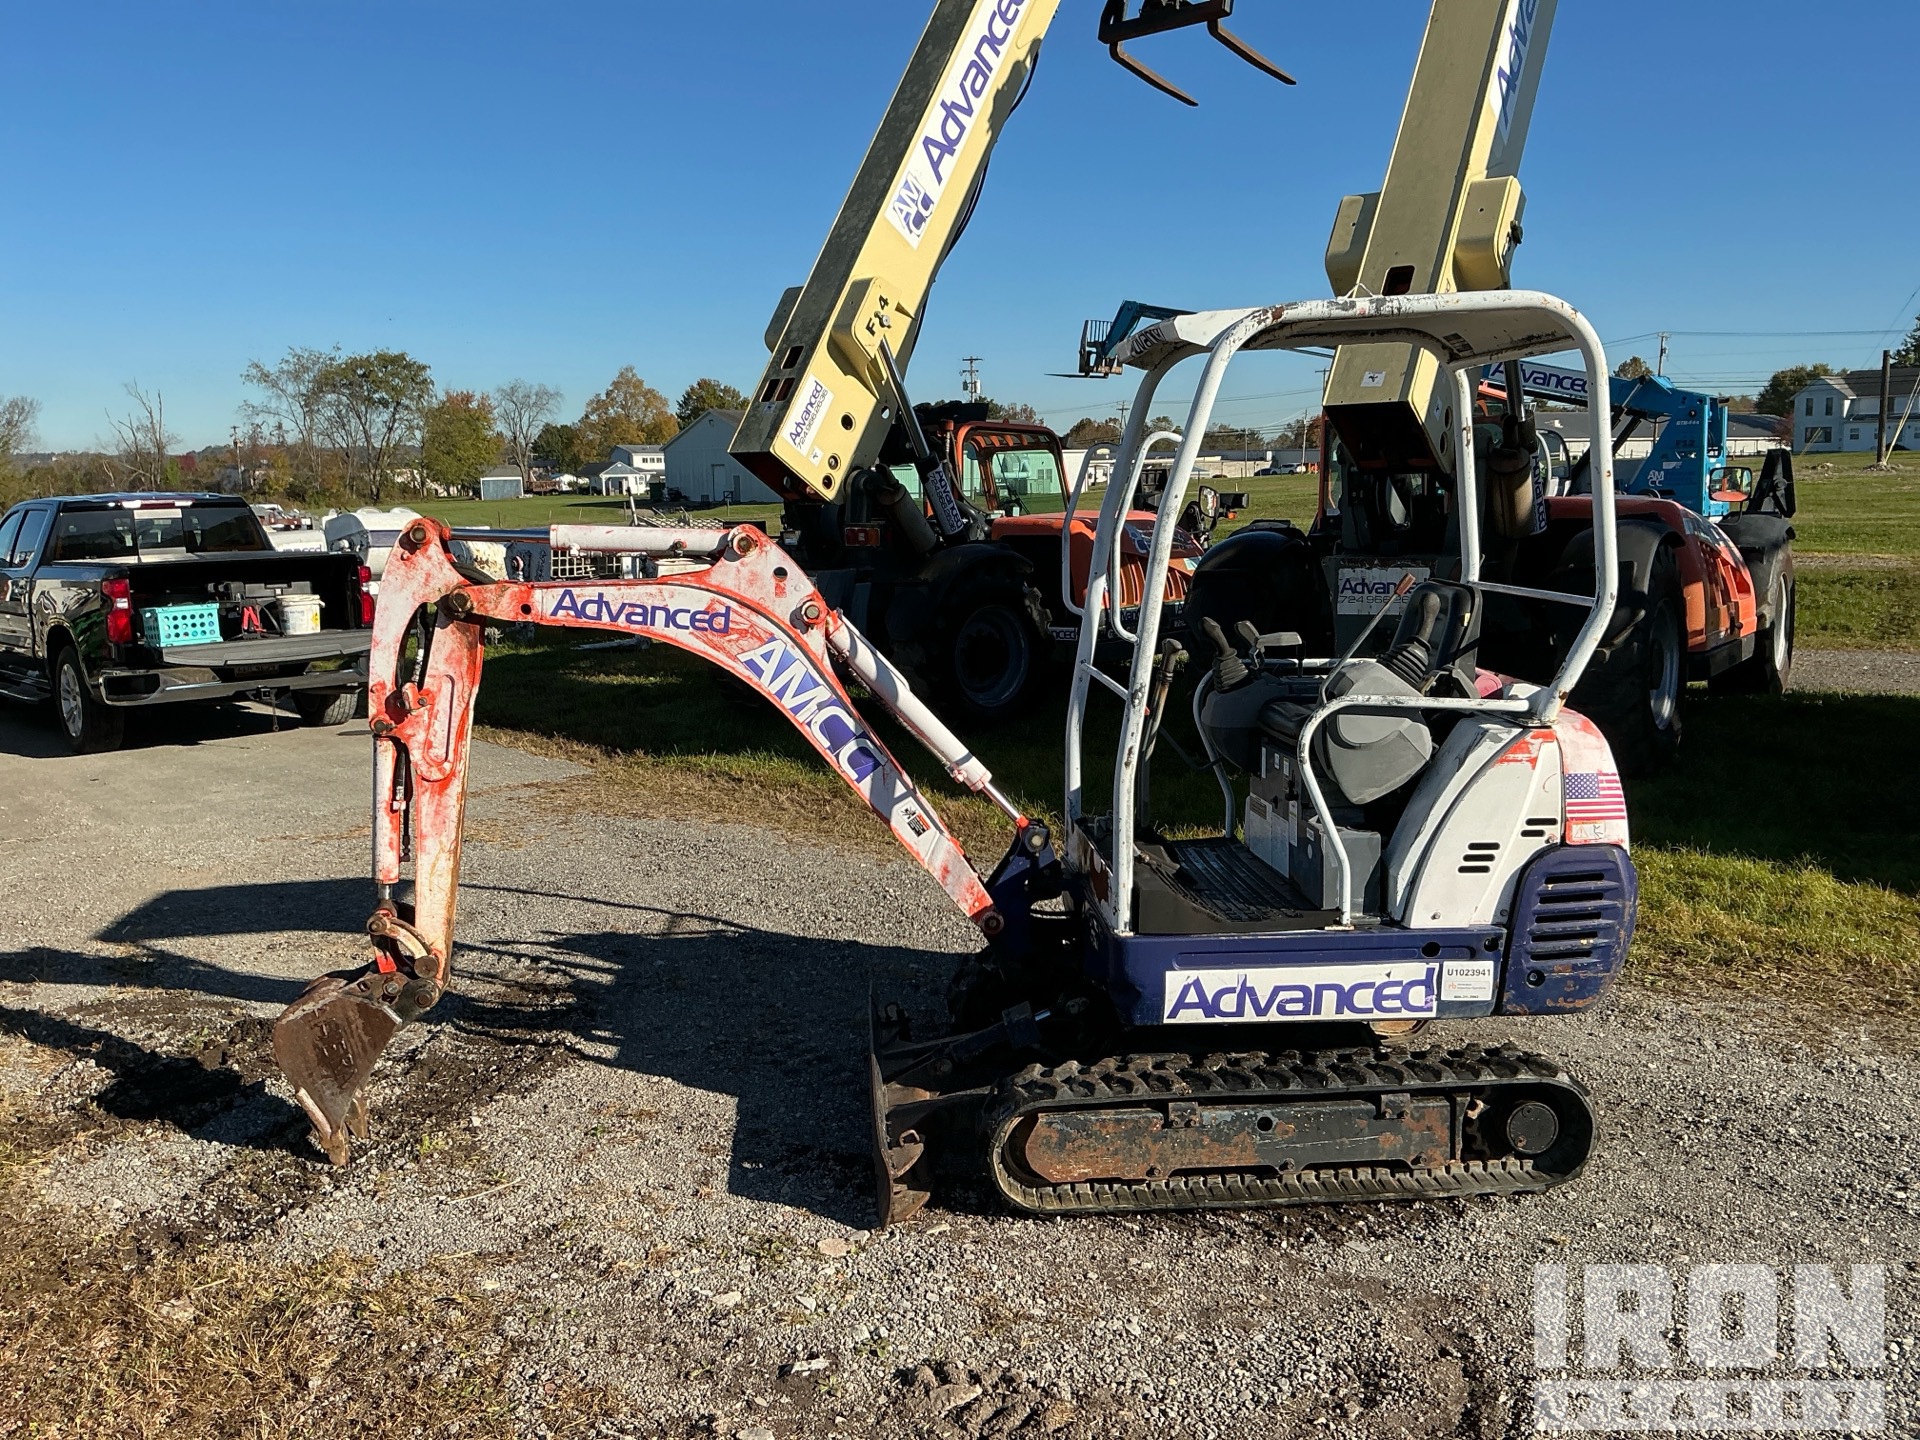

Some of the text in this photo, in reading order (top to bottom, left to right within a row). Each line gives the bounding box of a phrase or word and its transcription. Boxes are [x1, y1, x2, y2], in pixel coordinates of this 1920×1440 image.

[922, 0, 1025, 186] Advance
[1497, 0, 1537, 130] Adva
[1490, 361, 1587, 393] Avance
[788, 380, 824, 446] Advanced
[935, 470, 963, 529] Advanced
[551, 589, 731, 634] Advanced
[1167, 966, 1440, 1020] Advanced
[1447, 968, 1491, 977] U1023941
